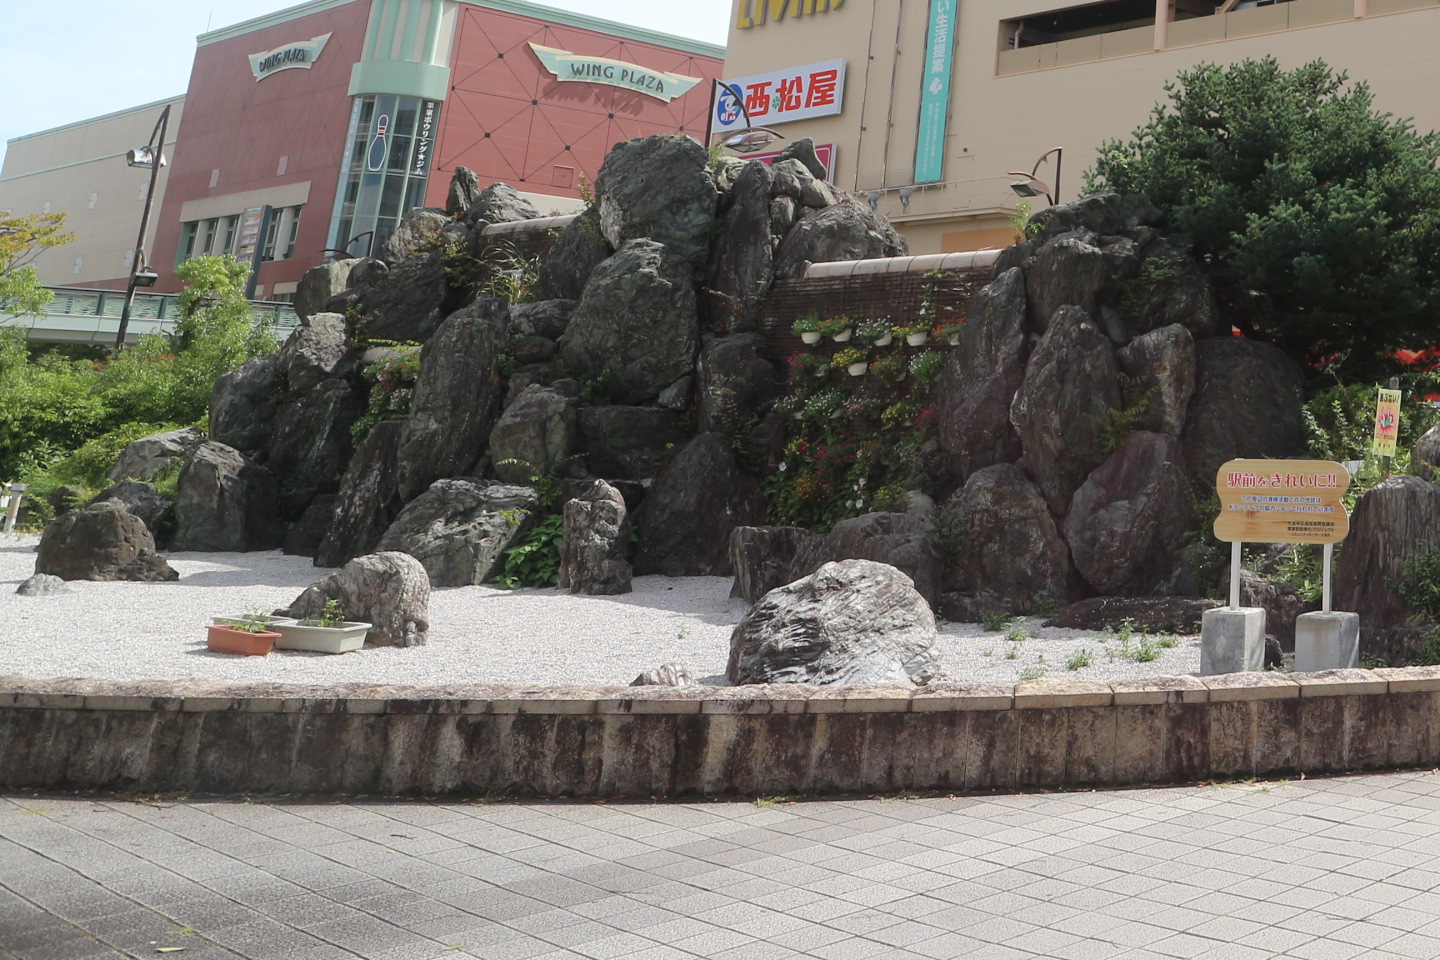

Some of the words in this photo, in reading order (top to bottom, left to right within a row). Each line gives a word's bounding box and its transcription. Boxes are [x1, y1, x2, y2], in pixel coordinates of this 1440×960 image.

[571, 63, 614, 79] WING
[621, 68, 664, 93] PLAZA
[743, 69, 838, 118] 西松屋
